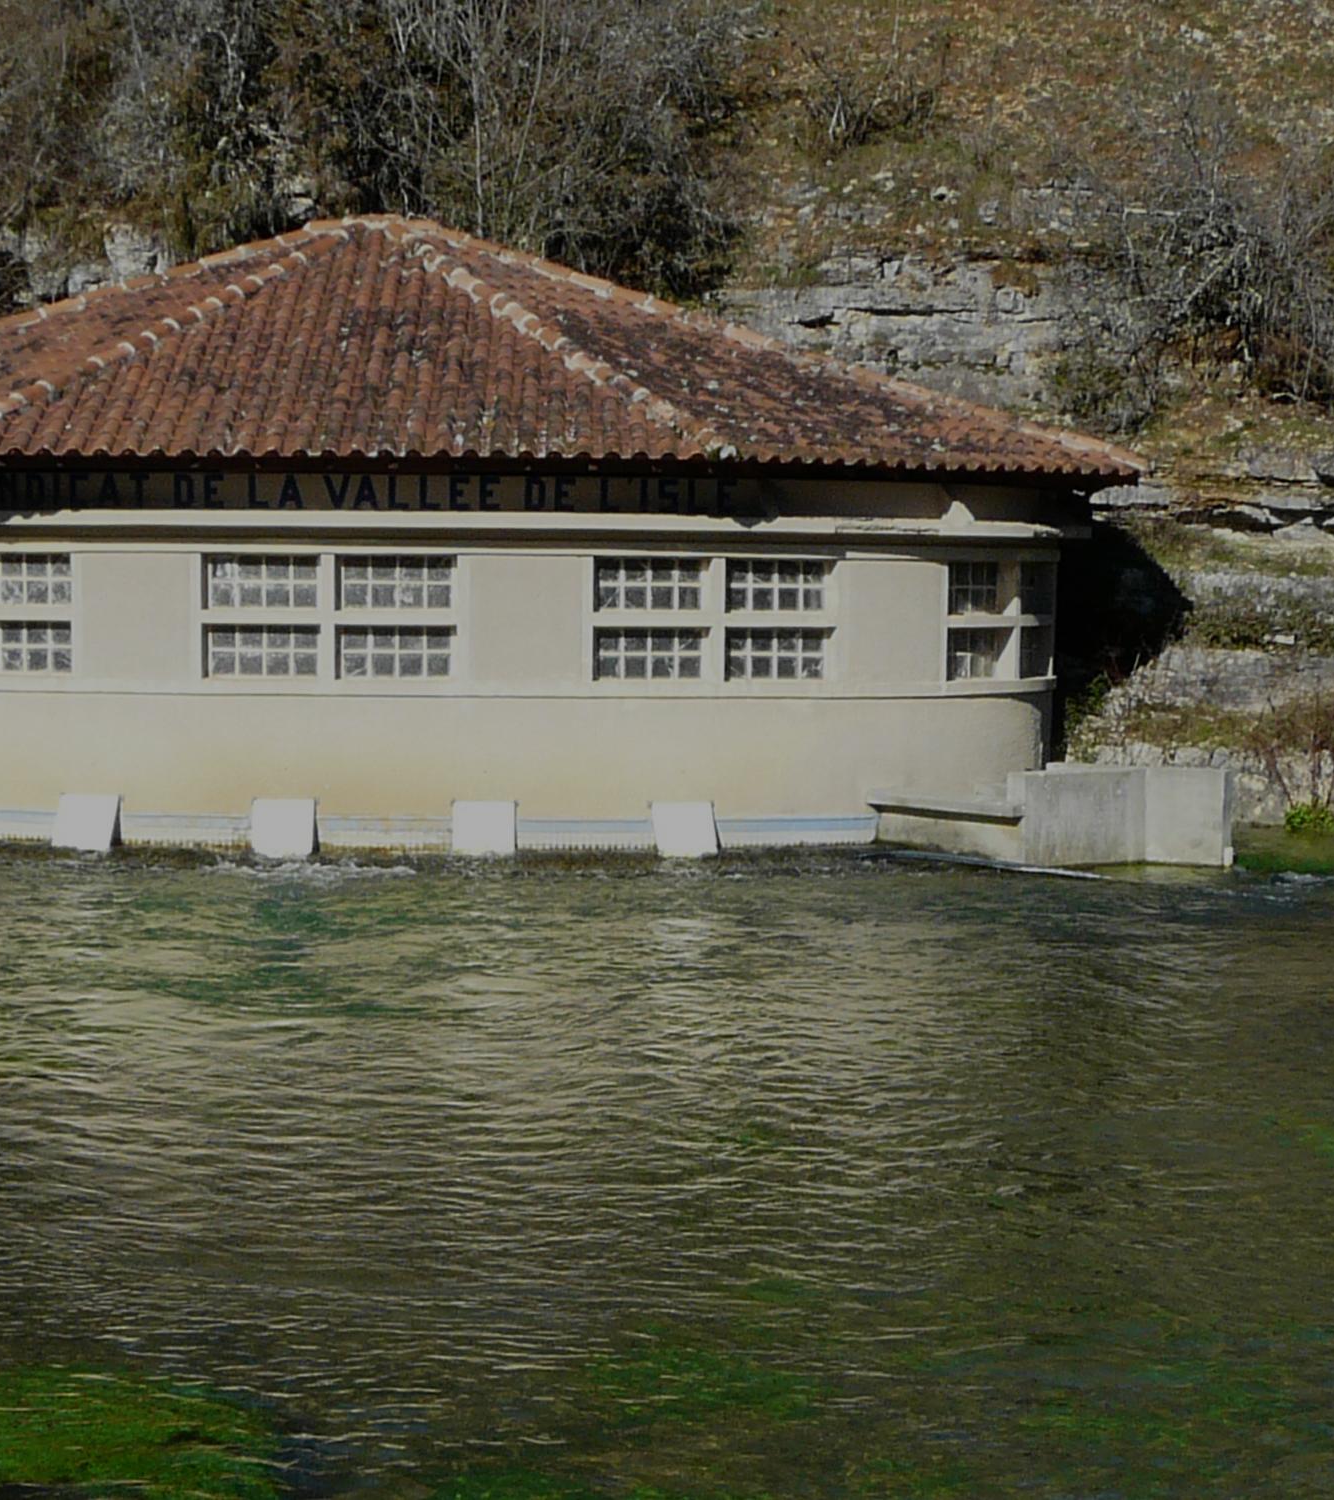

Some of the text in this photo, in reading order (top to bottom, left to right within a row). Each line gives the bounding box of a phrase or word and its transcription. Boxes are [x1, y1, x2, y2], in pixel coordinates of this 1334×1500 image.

[174, 472, 224, 508] DE
[249, 472, 303, 509] LA
[323, 473, 499, 510] VALLEE
[525, 475, 576, 511] DE
[601, 477, 737, 514] L'ISLE
